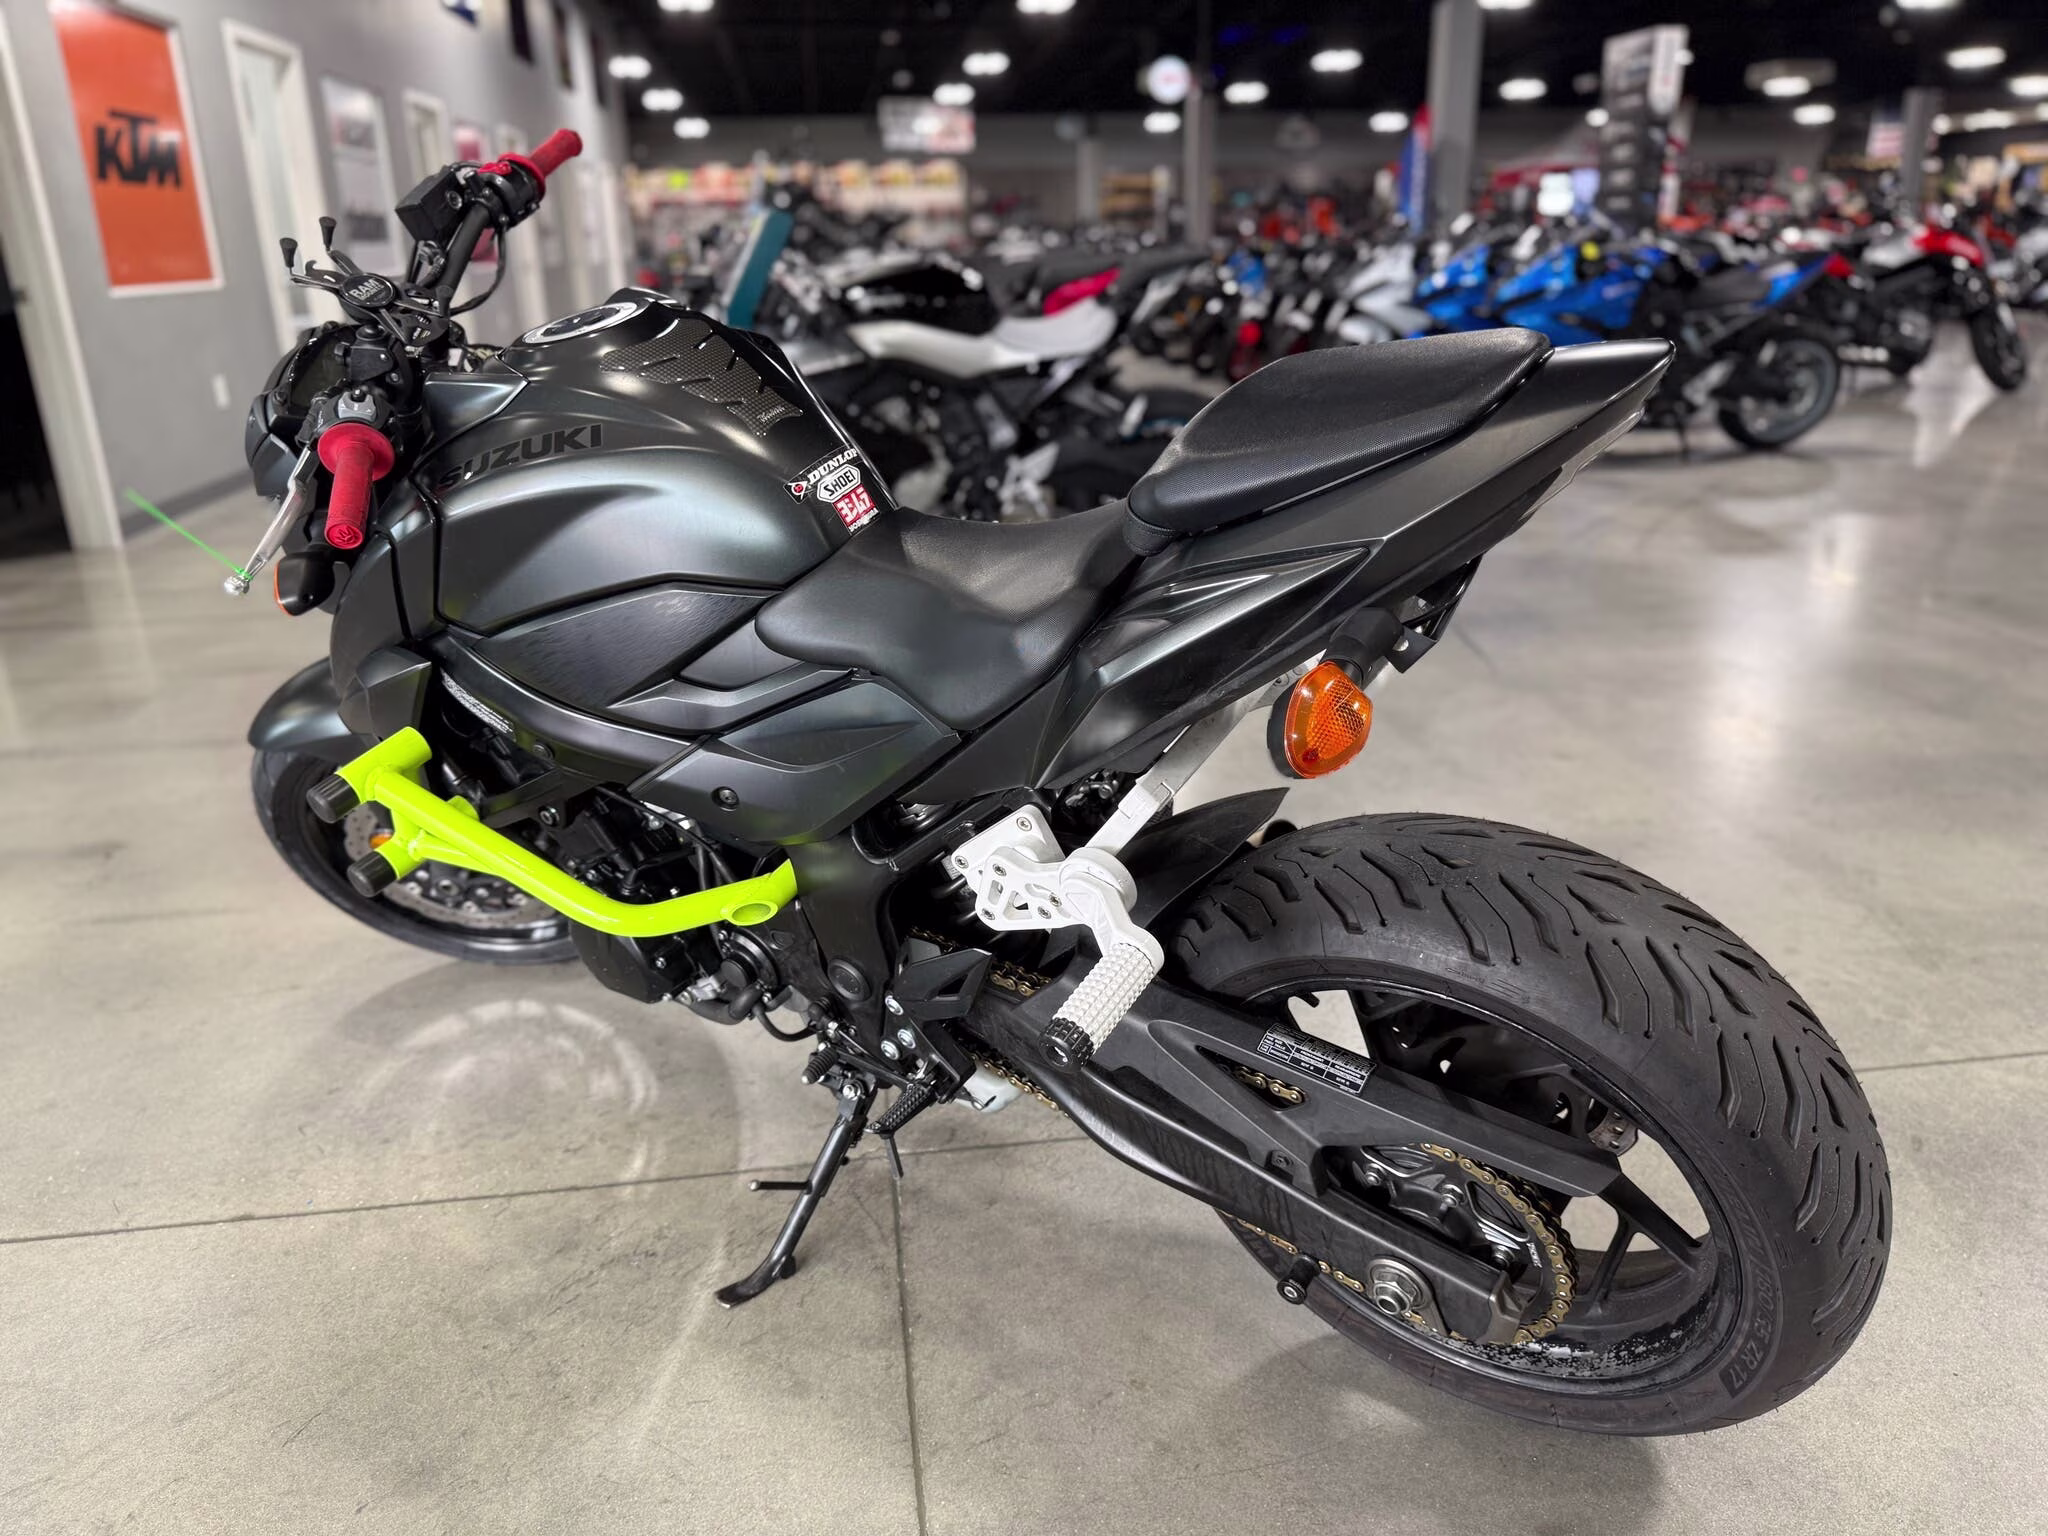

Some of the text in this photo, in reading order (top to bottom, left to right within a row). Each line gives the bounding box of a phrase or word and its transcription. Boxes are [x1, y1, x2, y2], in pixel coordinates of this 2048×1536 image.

[95, 108, 182, 191] KTM
[348, 278, 380, 299] RAM
[438, 424, 602, 488] SUZUKI
[807, 448, 858, 485] DUNLOP
[823, 469, 856, 497] SHOEI
[1739, 1339, 1764, 1371] ZR
[1728, 1363, 1749, 1391] 17
